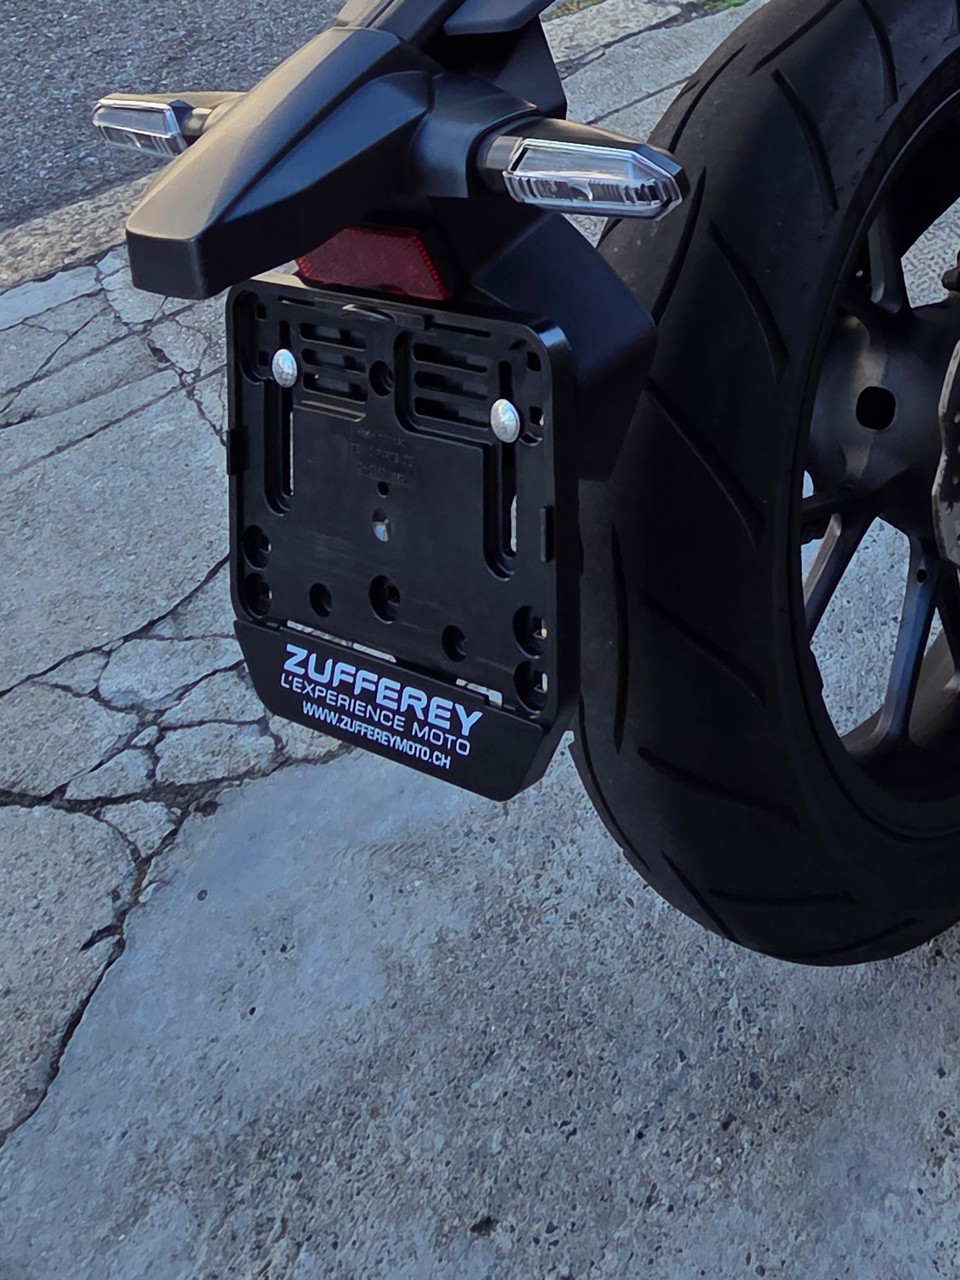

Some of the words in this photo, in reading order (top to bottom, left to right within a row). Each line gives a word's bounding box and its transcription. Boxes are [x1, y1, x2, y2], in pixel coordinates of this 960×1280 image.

[281, 673, 405, 731] L'EXPERIENCE
[412, 722, 470, 756] MOTO
[284, 643, 483, 736] ZUFFEREY
[303, 700, 451, 770] WWW.ZUFFEREYMOTO.CH
